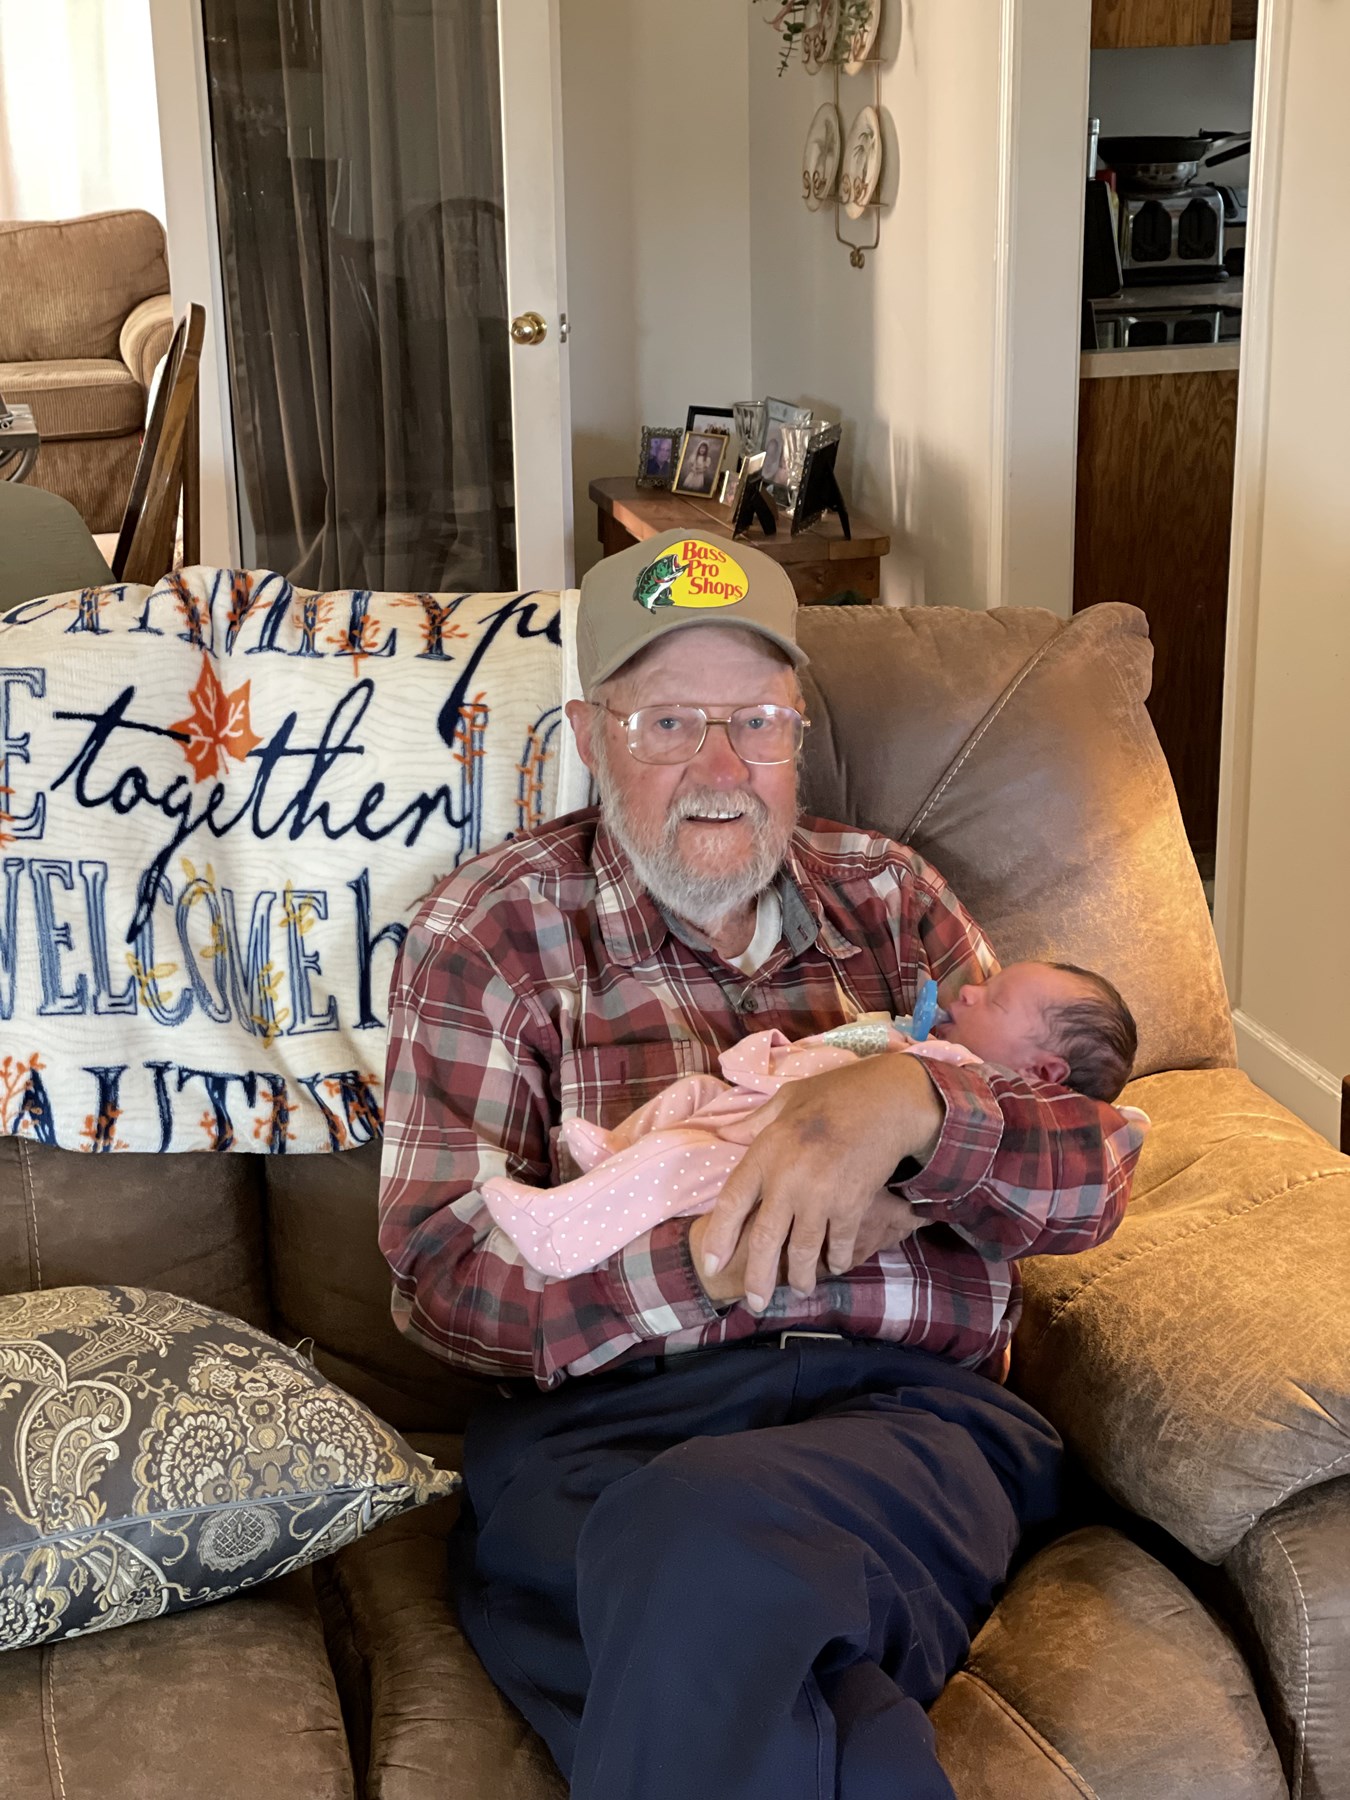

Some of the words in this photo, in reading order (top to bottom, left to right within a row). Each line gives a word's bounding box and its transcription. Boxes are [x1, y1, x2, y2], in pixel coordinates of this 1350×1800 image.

[682, 541, 727, 563] Bass
[687, 559, 719, 577] Pro
[688, 577, 743, 600] Shops
[51, 678, 472, 944] together
